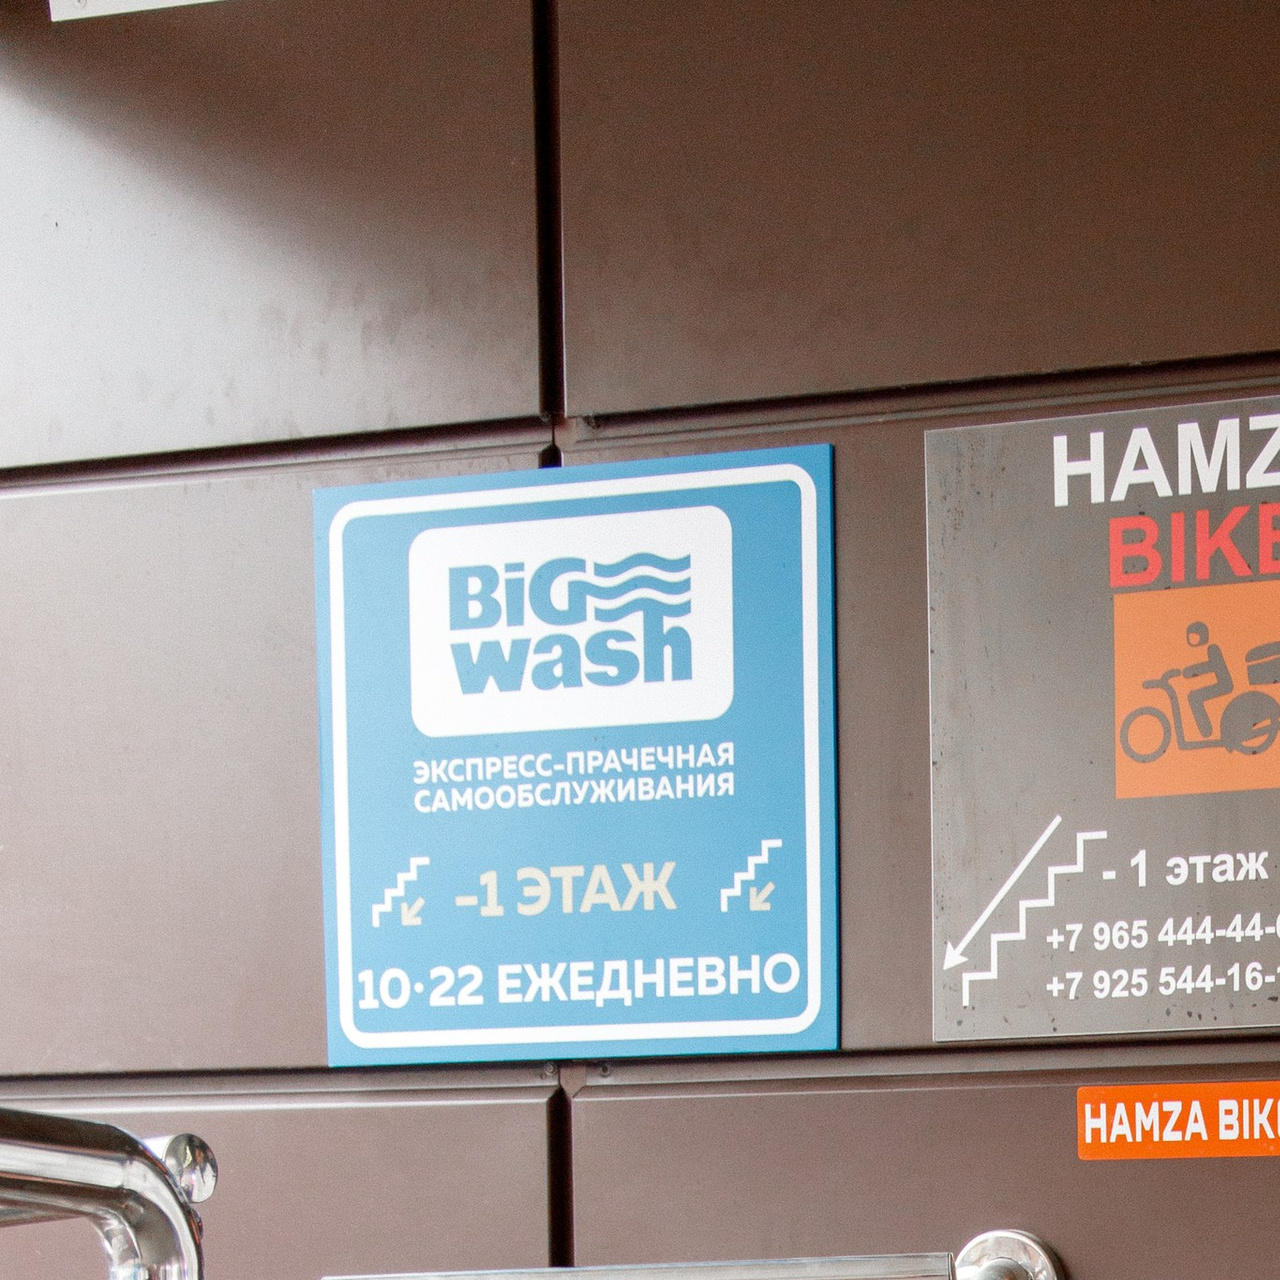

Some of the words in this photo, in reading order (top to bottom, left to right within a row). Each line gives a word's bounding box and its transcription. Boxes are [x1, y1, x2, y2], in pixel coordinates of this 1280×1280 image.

[451, 610, 694, 695] wash
[413, 742, 735, 784] ЭКСПРЕСС-ПРАЧЕЧНАЯ
[414, 772, 735, 814] САМООБСЛУЖИВАНИЯ
[455, 871, 504, 917] -1
[517, 862, 677, 916] ЭТАЖ
[1165, 851, 1269, 886] этаж
[1046, 922, 1083, 953] +7
[1092, 919, 1148, 951] 965
[498, 952, 800, 1007] ЕЖЕДНЕВНО
[1046, 970, 1083, 999] +7
[1092, 967, 1149, 998] 925
[1084, 1101, 1209, 1144] HAMZA
